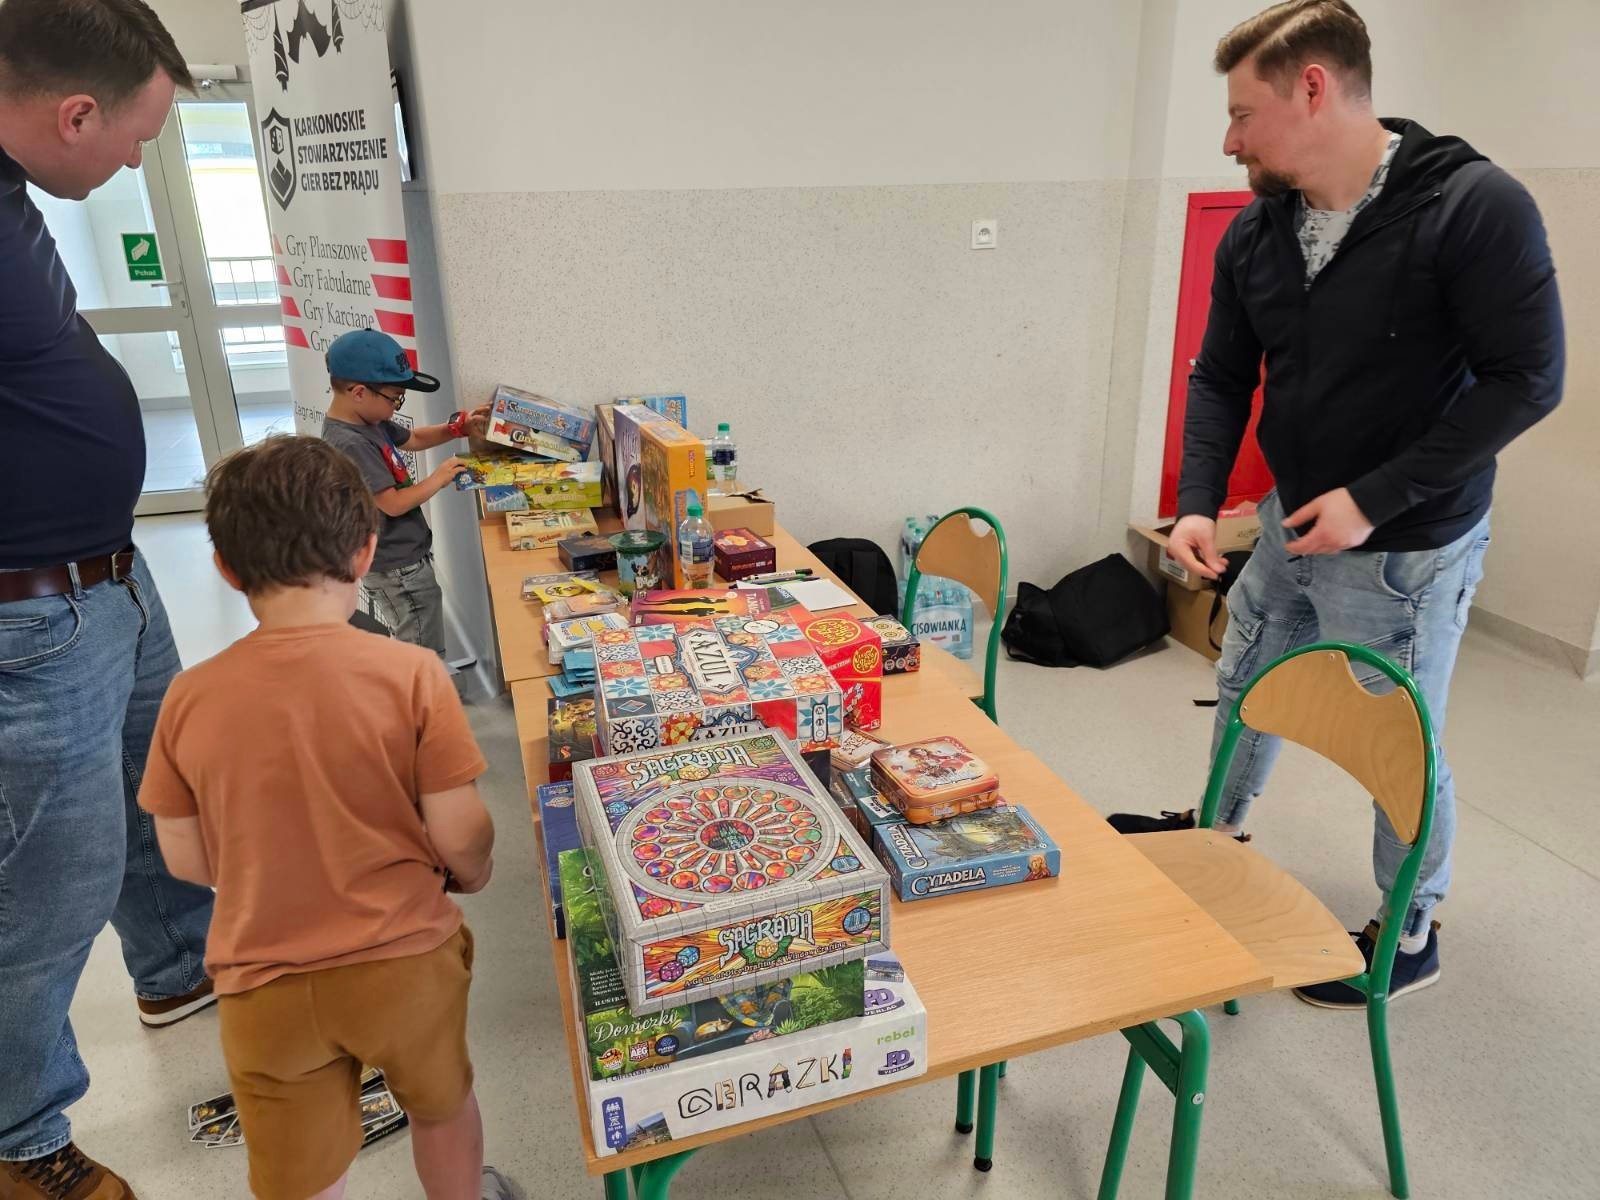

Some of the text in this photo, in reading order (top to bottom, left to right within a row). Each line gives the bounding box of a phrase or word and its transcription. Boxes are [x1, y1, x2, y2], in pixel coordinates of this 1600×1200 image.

[294, 109, 366, 136] KARKONOSKIE
[298, 138, 388, 164] STOWARZYSZENIE
[301, 170, 379, 195] GIER BEZ PRĄDU
[286, 234, 368, 264] Gry Planszowe
[293, 266, 371, 296] Gry Fabularne
[303, 299, 374, 328] Gry Karciane
[911, 618, 967, 637] CISOWIANKA
[690, 640, 731, 681] AZUL
[625, 744, 760, 790] SAGRADA
[887, 824, 928, 870] CYTADELA
[911, 867, 986, 896] CYTADELA
[718, 909, 816, 968] SAGRADA
[593, 1009, 680, 1044] Doniczki
[876, 1026, 915, 1045] rebel
[630, 1047, 649, 1058] AEG
[678, 1048, 852, 1118] OBRAZKI
